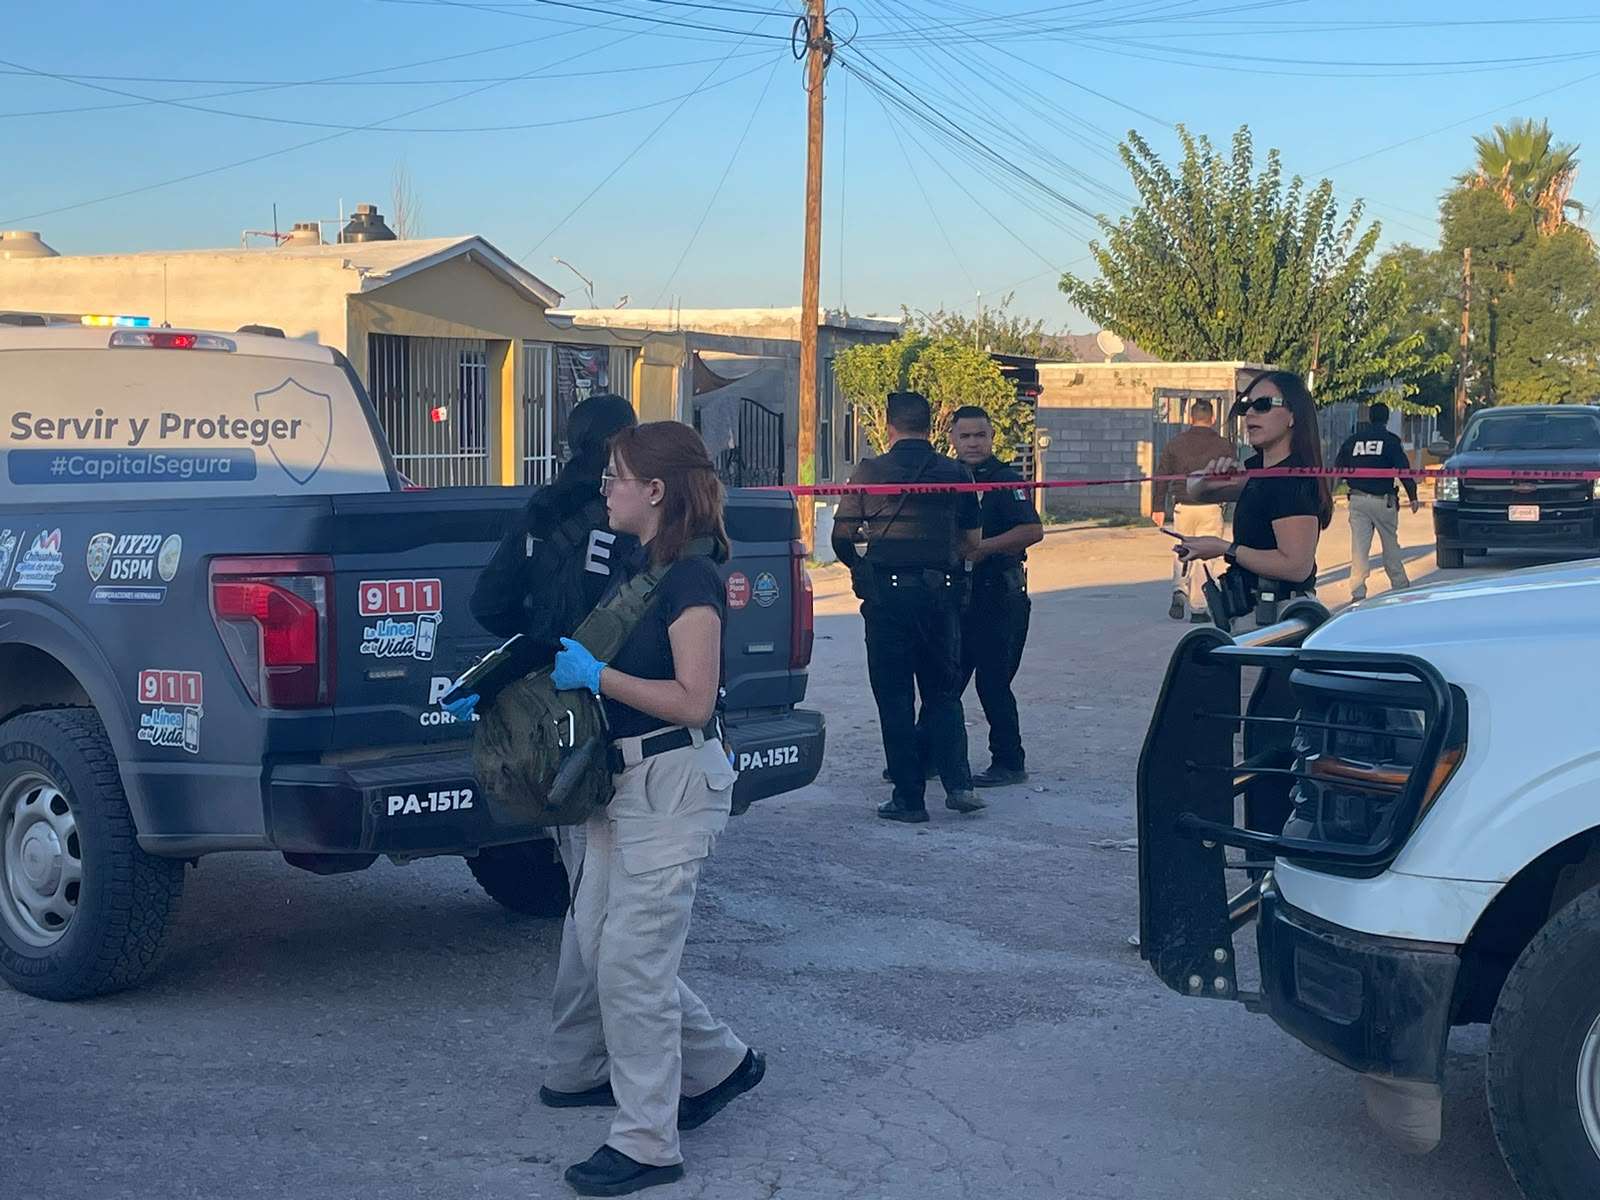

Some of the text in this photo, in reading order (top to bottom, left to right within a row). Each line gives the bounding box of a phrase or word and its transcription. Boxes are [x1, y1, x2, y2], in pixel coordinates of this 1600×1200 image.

[10, 409, 301, 446] Servir y Proteger
[1352, 440, 1384, 457] AEI
[51, 453, 232, 479] #CapitalSegura
[113, 535, 162, 554] NYPD
[110, 559, 154, 579] DSPM
[366, 584, 433, 610] 911
[377, 619, 414, 637] Línea
[377, 638, 415, 655] Vida
[145, 675, 196, 700] 911
[152, 708, 183, 726] Línea
[152, 727, 184, 744] Vida
[739, 745, 799, 772] PA-1512
[387, 788, 474, 816] PA-1512
